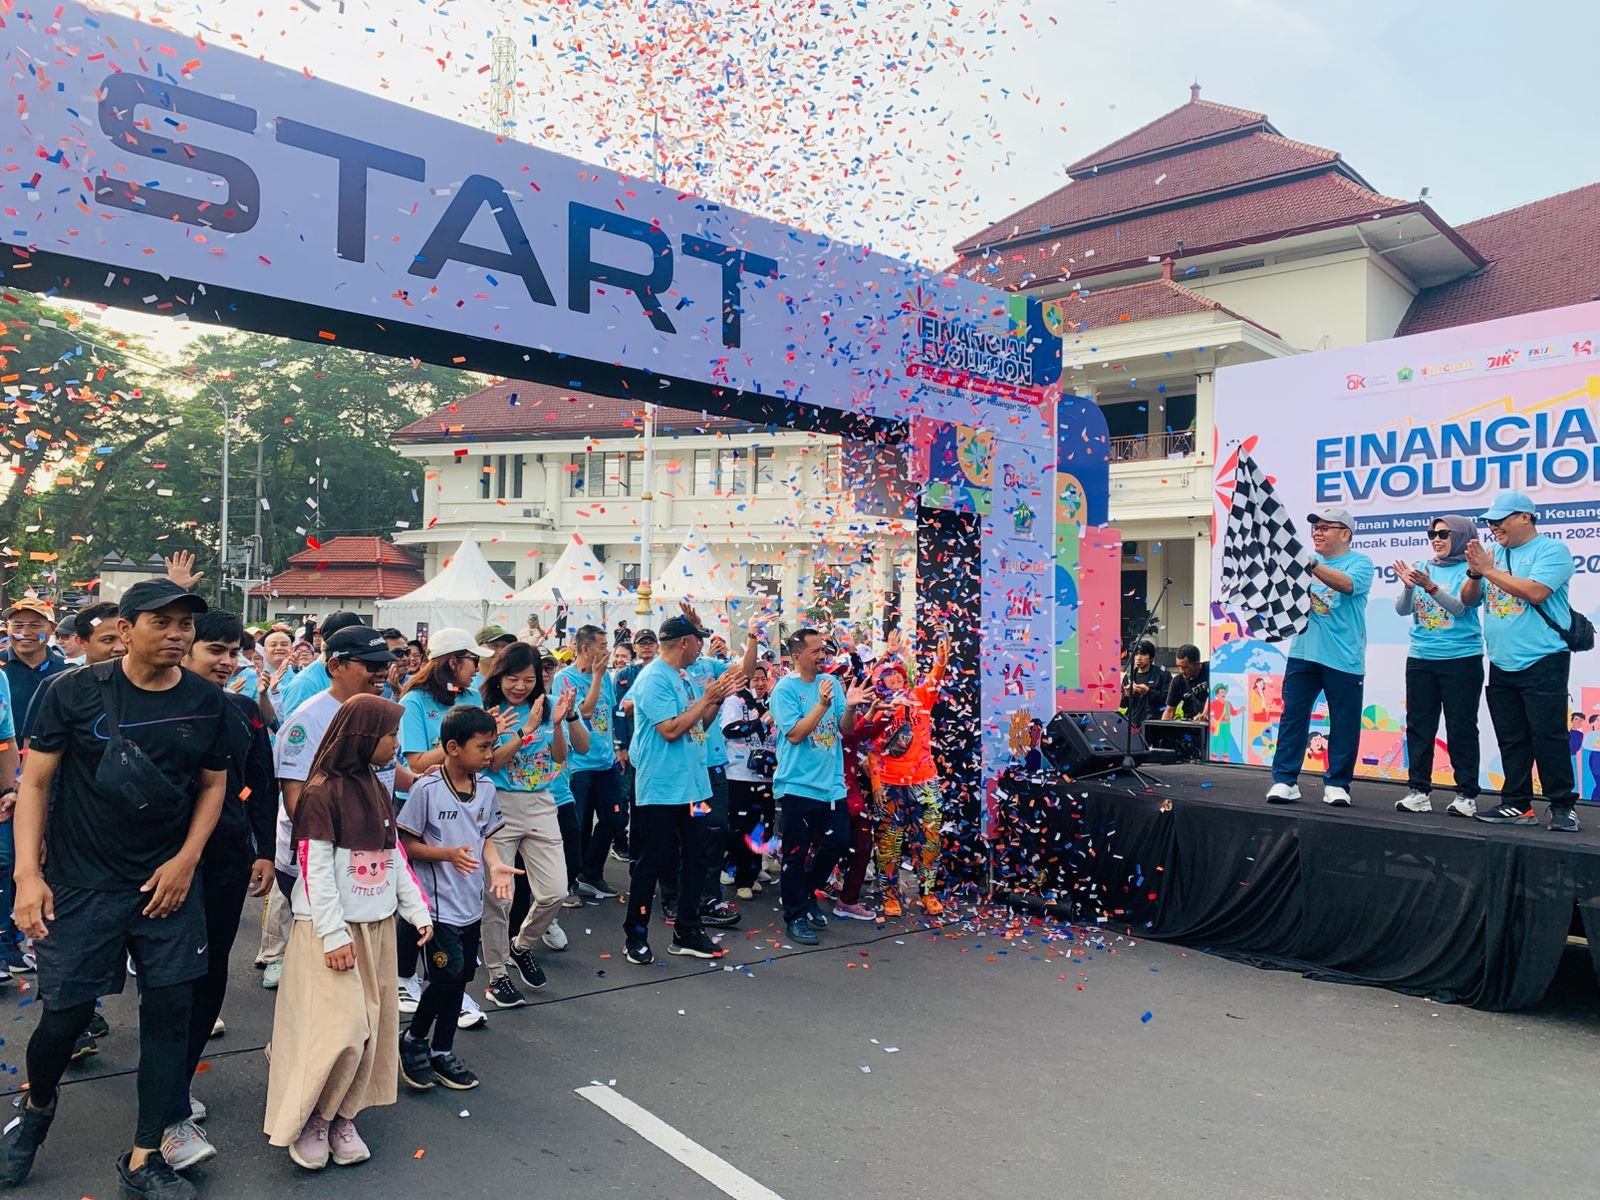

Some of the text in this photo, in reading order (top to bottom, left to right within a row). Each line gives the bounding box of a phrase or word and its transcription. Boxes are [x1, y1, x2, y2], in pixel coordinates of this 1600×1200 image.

[94, 72, 778, 350] START
[1393, 516, 1433, 529] Menu
[1350, 538, 1388, 549] uncak
[1390, 537, 1429, 548] Bulan
[351, 884, 375, 897] LITTLE
